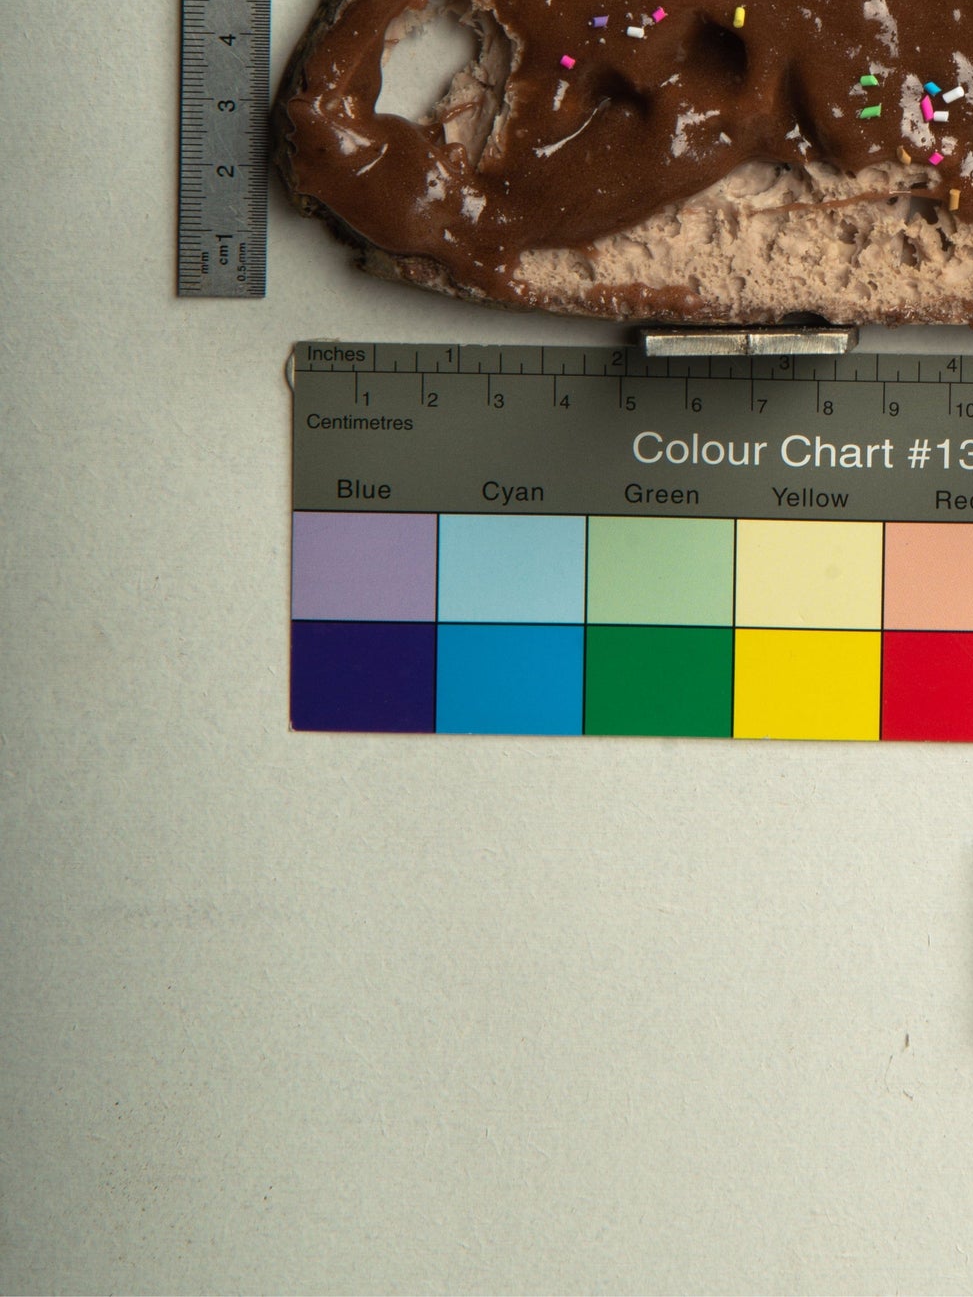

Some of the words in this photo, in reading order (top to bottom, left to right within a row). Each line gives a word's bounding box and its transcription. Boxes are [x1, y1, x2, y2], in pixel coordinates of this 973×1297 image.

[218, 33, 237, 47] 4
[217, 99, 236, 113] 3
[216, 165, 235, 178] 2
[307, 345, 366, 362] Inches
[445, 349, 453, 363] 1
[611, 351, 626, 367] 2
[778, 355, 790, 371] 3
[946, 357, 958, 373] 4
[362, 391, 370, 407] 1
[427, 392, 439, 408] 2
[493, 393, 505, 409] 3
[559, 394, 571, 410] 4
[625, 395, 637, 412] 5
[691, 397, 703, 413] 6
[756, 399, 768, 414] 7
[822, 400, 834, 416] 8
[888, 401, 900, 417] 9
[306, 413, 414, 431] Centimetres
[633, 431, 768, 466] Colour
[781, 434, 894, 469] Chart
[337, 478, 391, 500] Blue
[482, 480, 544, 507] Cyan
[624, 483, 699, 505] Green
[771, 486, 849, 508] Yellow
